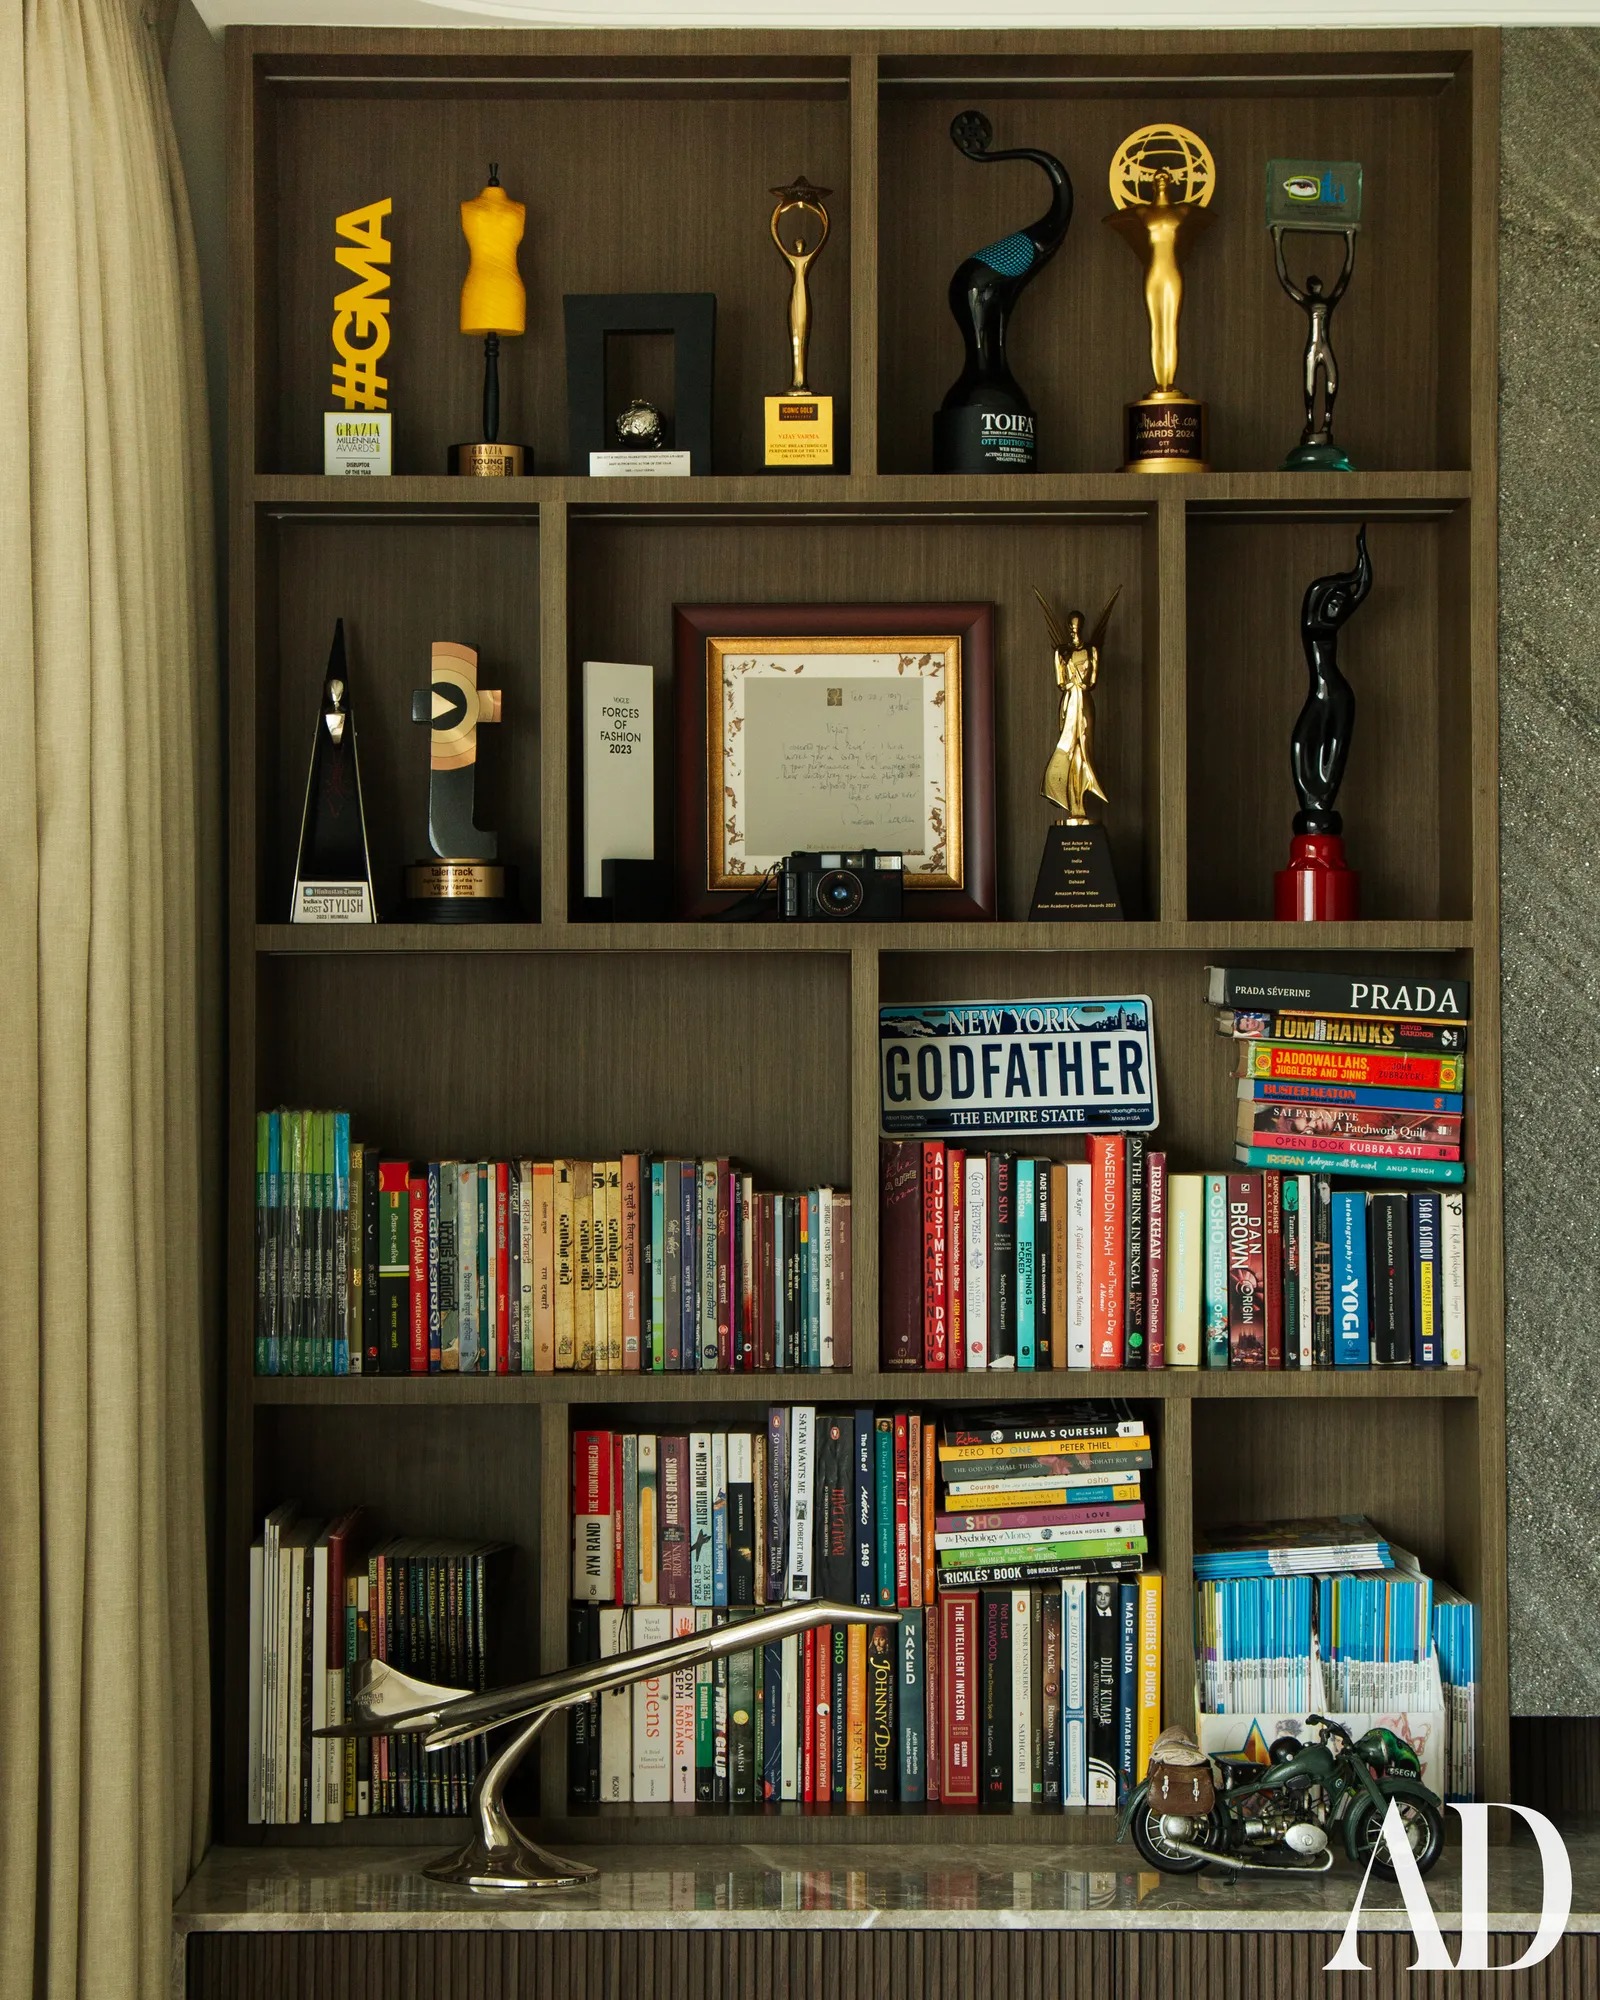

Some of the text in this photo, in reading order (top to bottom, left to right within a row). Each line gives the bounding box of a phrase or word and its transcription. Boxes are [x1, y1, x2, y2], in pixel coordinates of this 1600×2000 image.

[332, 197, 392, 411] #GMA
[782, 406, 814, 414] ICONIC GOLD
[981, 413, 1034, 434] TOIFA
[336, 422, 381, 436] GRAZIA
[981, 438, 997, 446] OTT
[1136, 430, 1195, 440] AWARDS 2024
[336, 444, 375, 452] AWARDS
[471, 446, 503, 455] GRAZIA
[471, 458, 504, 466] YOUNG
[602, 707, 640, 719] FORCES
[614, 720, 627, 730] OF
[600, 731, 641, 742] FASHION
[609, 744, 632, 754] 2023
[314, 887, 362, 896] Hindustan Times
[323, 898, 364, 913] STYLISH
[1235, 985, 1311, 998] PRADA SÉVERINE
[1350, 983, 1461, 1014] PRADA
[947, 1006, 1081, 1035] NEW YORK
[1274, 1018, 1396, 1046] TOM HANKS
[1400, 1024, 1422, 1032] DAVID
[1400, 1030, 1434, 1039] GARDNER
[886, 1040, 1147, 1103] GODFATHER
[1275, 1051, 1370, 1071] JADOOWALLAHS,
[1275, 1065, 1367, 1080] JUGGLERS AND JINNS
[1263, 1084, 1356, 1099] BUSTER KEATON
[950, 1108, 1086, 1125] THE EMPIRE STATE
[1273, 1108, 1359, 1122] SAI PARANJPYE
[1333, 1122, 1426, 1138] A Patchwork Quilt
[1266, 1154, 1305, 1166] IRRFAN
[1275, 1136, 1422, 1156] OPEN BOOK KUBBRA SAIT
[1410, 1166, 1435, 1175] SINGH
[952, 1183, 960, 1207] Kapoor
[999, 1164, 1007, 1224] RED SUN
[1103, 1142, 1115, 1256] NASEERUDDIN SHAH
[1130, 1140, 1143, 1288] ON THE BRINK IN BENGAL
[1150, 1166, 1162, 1260] IRRFAN KHAN
[1210, 1195, 1224, 1244] OSHO
[1230, 1202, 1249, 1269] BROWN
[1248, 1217, 1262, 1254] DAN
[1419, 1198, 1433, 1260] ISAAC ASIMOV
[934, 1152, 944, 1349] ADJUSTMENT DAY
[1314, 1241, 1331, 1316] AL PACINO
[1105, 1260, 1116, 1336] And Then One Day
[1150, 1268, 1160, 1333] Aseem Chhabra
[1341, 1279, 1359, 1340] YOGI
[1014, 1427, 1108, 1440] HUMA S QURESHI
[1059, 1441, 1112, 1452] PETER THIEL
[798, 1413, 808, 1494] SATAN WANTS ME
[958, 1446, 1032, 1457] ZERO TO ONE
[588, 1445, 599, 1513] THE FOUNTAINHEAD
[861, 1463, 868, 1472] of
[666, 1457, 678, 1525] ANGELS DEMONS
[696, 1453, 707, 1526] ALISTAIR MACLEAN
[586, 1523, 601, 1577] AYN RAND
[796, 1522, 804, 1573] ROBERT IRWIN
[861, 1542, 870, 1567] 1949
[898, 1523, 907, 1587] RONNIE SCREWVALA
[993, 1567, 1022, 1581] BOOK
[1125, 1602, 1134, 1635] MADE
[835, 1632, 844, 1664] OSHO
[905, 1625, 916, 1685] NAKED
[1125, 1643, 1133, 1673] INDIA
[1144, 1589, 1158, 1708] DAUGHTERS OF DURGA
[955, 1606, 965, 1720] THE INTELLIGENT INVESTOR
[1100, 1657, 1114, 1726] DILIP KUMAR
[684, 1704, 693, 1741] EARLY
[870, 1657, 891, 1771] JOHNNY DEPP
[675, 1704, 684, 1756] INDIANS
[715, 1686, 727, 1778] FIGHT CLUB
